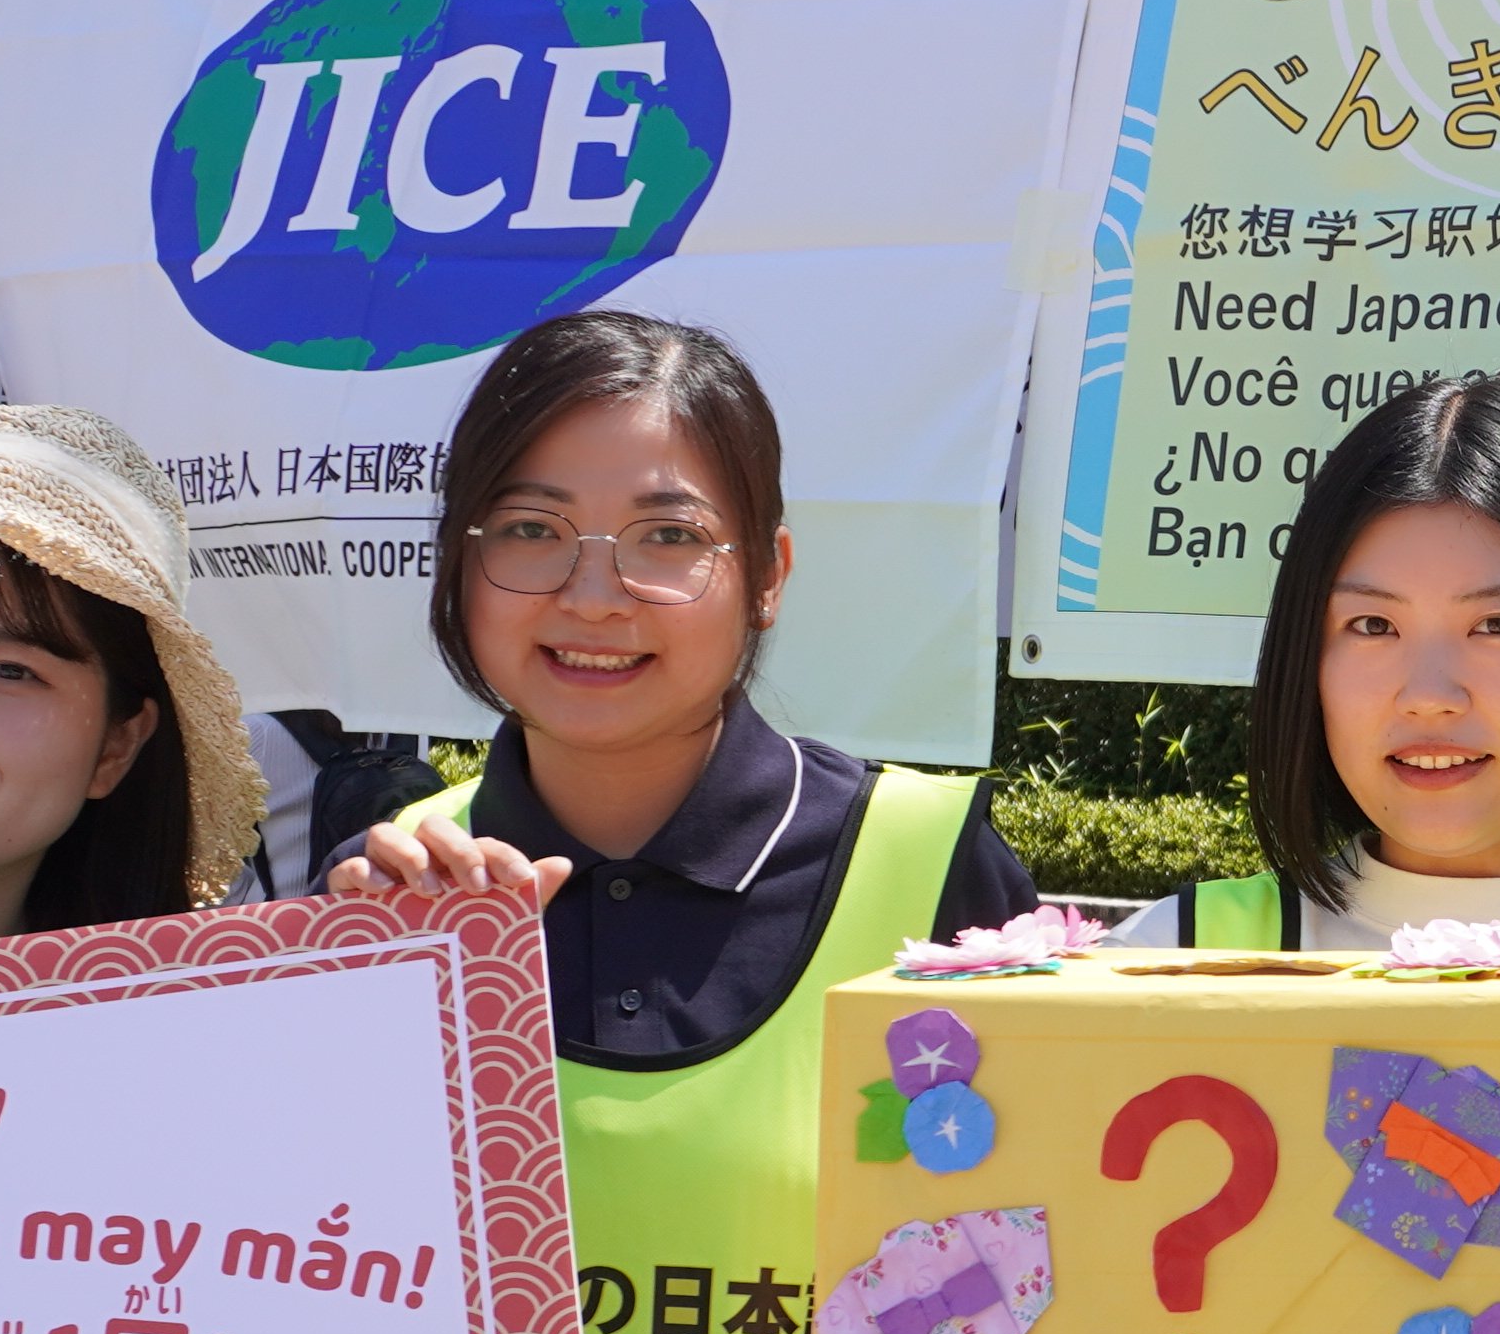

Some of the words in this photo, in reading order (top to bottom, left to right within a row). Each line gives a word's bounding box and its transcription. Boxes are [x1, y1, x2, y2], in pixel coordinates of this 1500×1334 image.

[192, 41, 667, 282] JICE
[1173, 279, 1317, 334] Need
[1168, 356, 1298, 408] Você
[1153, 431, 1262, 496] ¿No
[1148, 506, 1247, 567] Bạn
[20, 1206, 201, 1286] may
[220, 1203, 437, 1309] mắn!
[123, 1282, 183, 1316] かい
